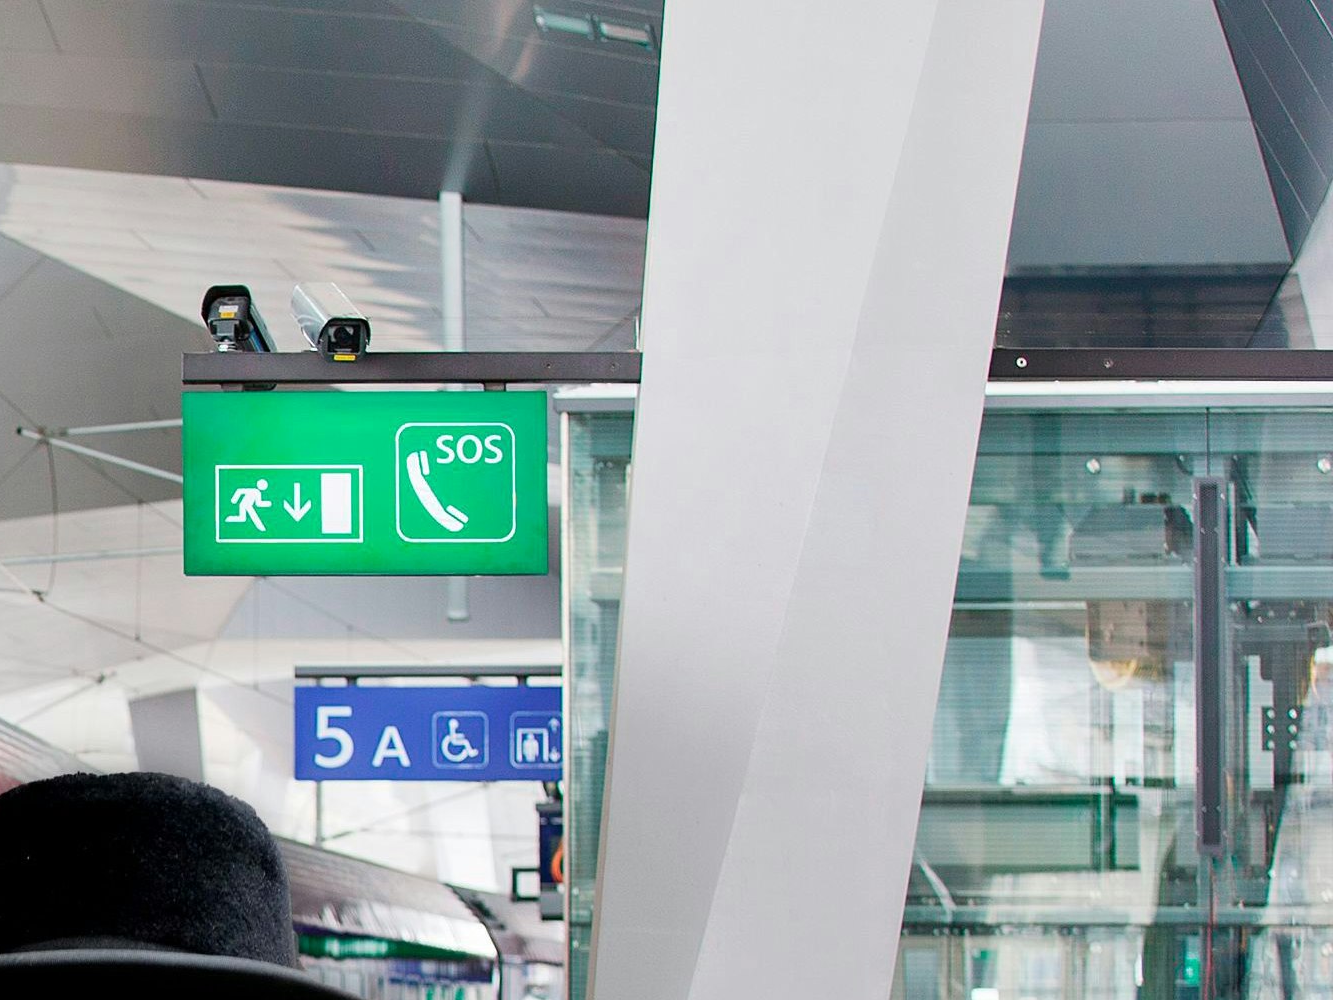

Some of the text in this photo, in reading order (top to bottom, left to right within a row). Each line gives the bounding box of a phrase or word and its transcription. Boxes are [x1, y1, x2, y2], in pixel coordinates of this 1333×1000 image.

[436, 434, 503, 464] SOS
[314, 705, 412, 769] 5 A
